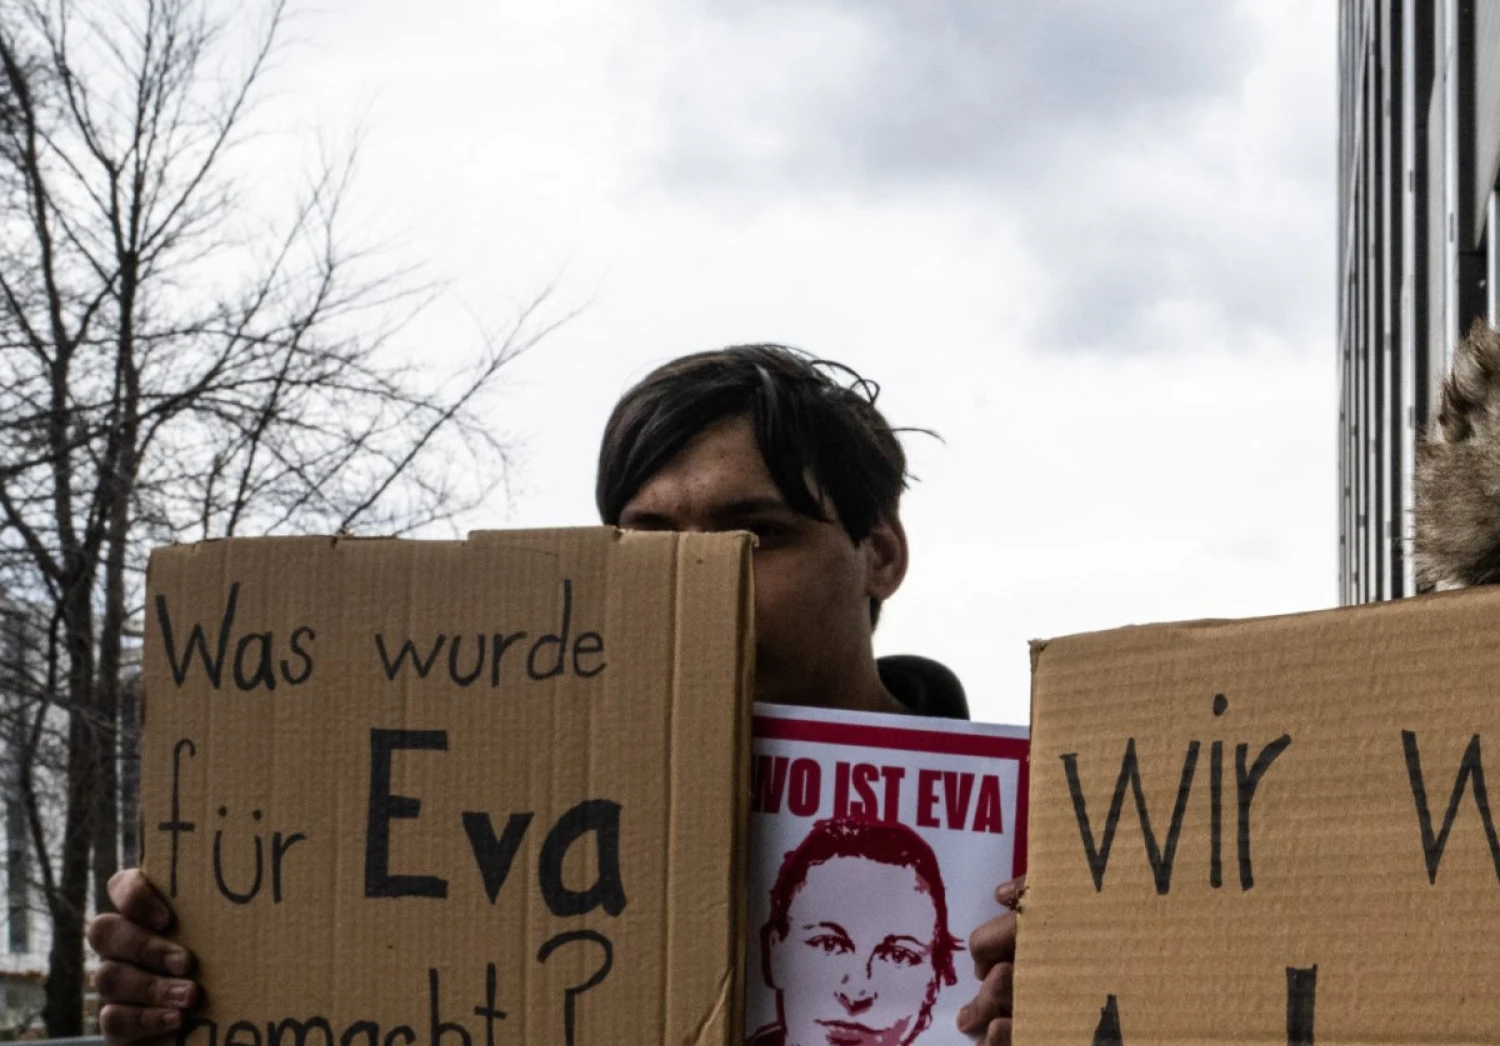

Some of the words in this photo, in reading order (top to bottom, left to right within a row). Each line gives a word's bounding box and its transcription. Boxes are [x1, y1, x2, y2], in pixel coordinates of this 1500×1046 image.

[155, 581, 315, 692] Was
[374, 578, 608, 688] wurde
[158, 738, 308, 906] für
[363, 727, 627, 918] Eva
[833, 761, 906, 824] IST
[915, 769, 1004, 835] EVA
[1060, 693, 1292, 895] wir
